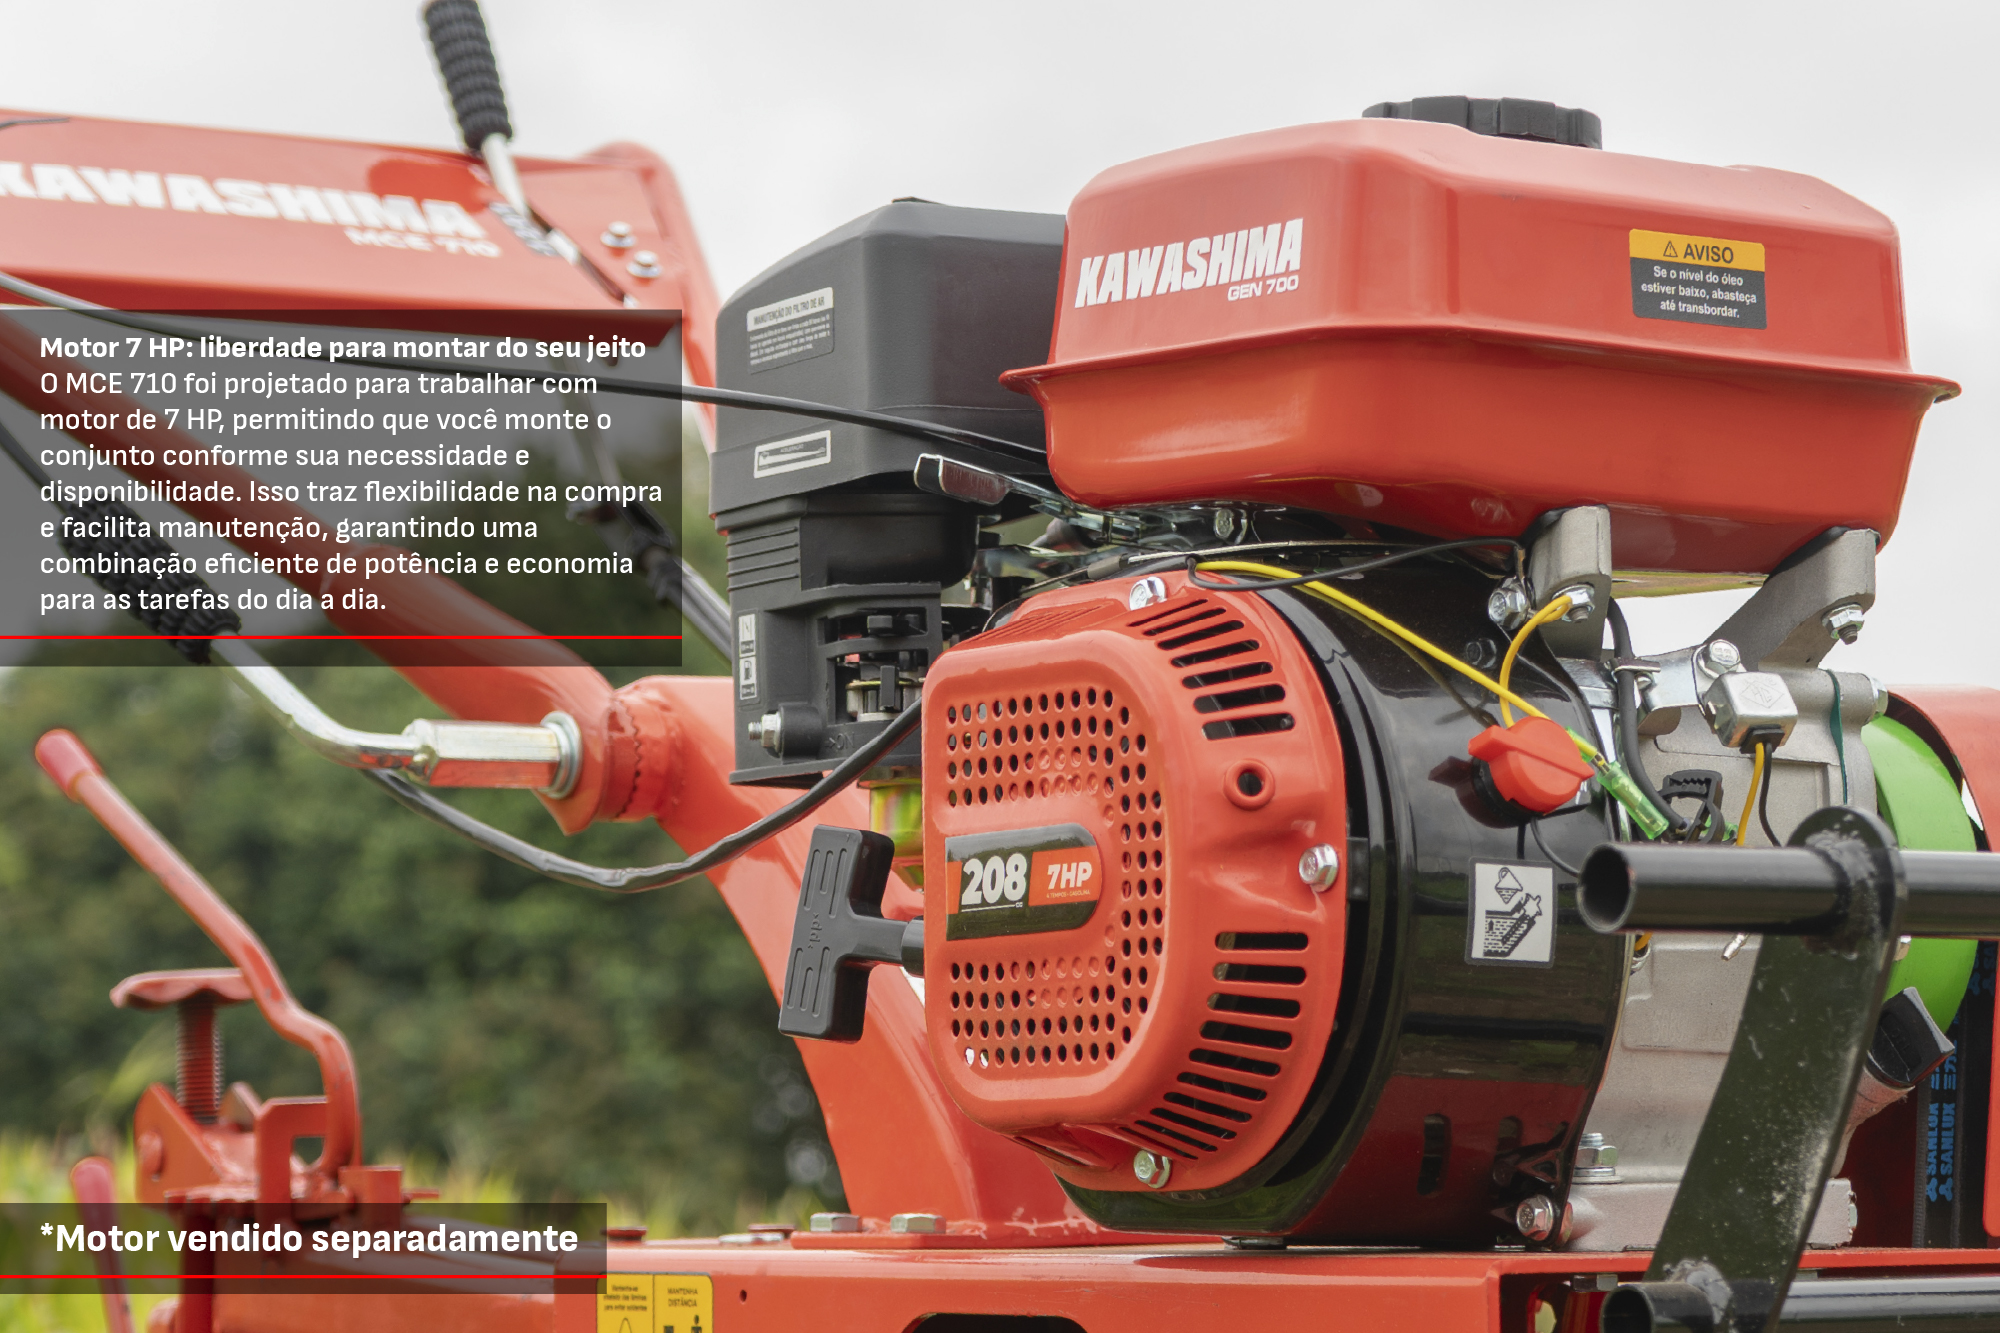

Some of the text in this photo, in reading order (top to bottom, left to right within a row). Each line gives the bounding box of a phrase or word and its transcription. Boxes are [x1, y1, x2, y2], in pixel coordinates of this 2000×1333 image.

[344, 226, 434, 251] MCE
[1075, 218, 1303, 308] KAWASHIMA
[1683, 243, 1734, 264] AVISO
[1653, 265, 1744, 286] Se o nível do óleo
[1227, 275, 1299, 301] GEN 700
[1641, 282, 1757, 305] estiver baixo, abasteça
[1660, 300, 1740, 318] até transbordar.
[961, 853, 1092, 905] 208 7HP
[1940, 1103, 1955, 1175] SANLUX
[667, 1287, 698, 1295] MANTENHA
